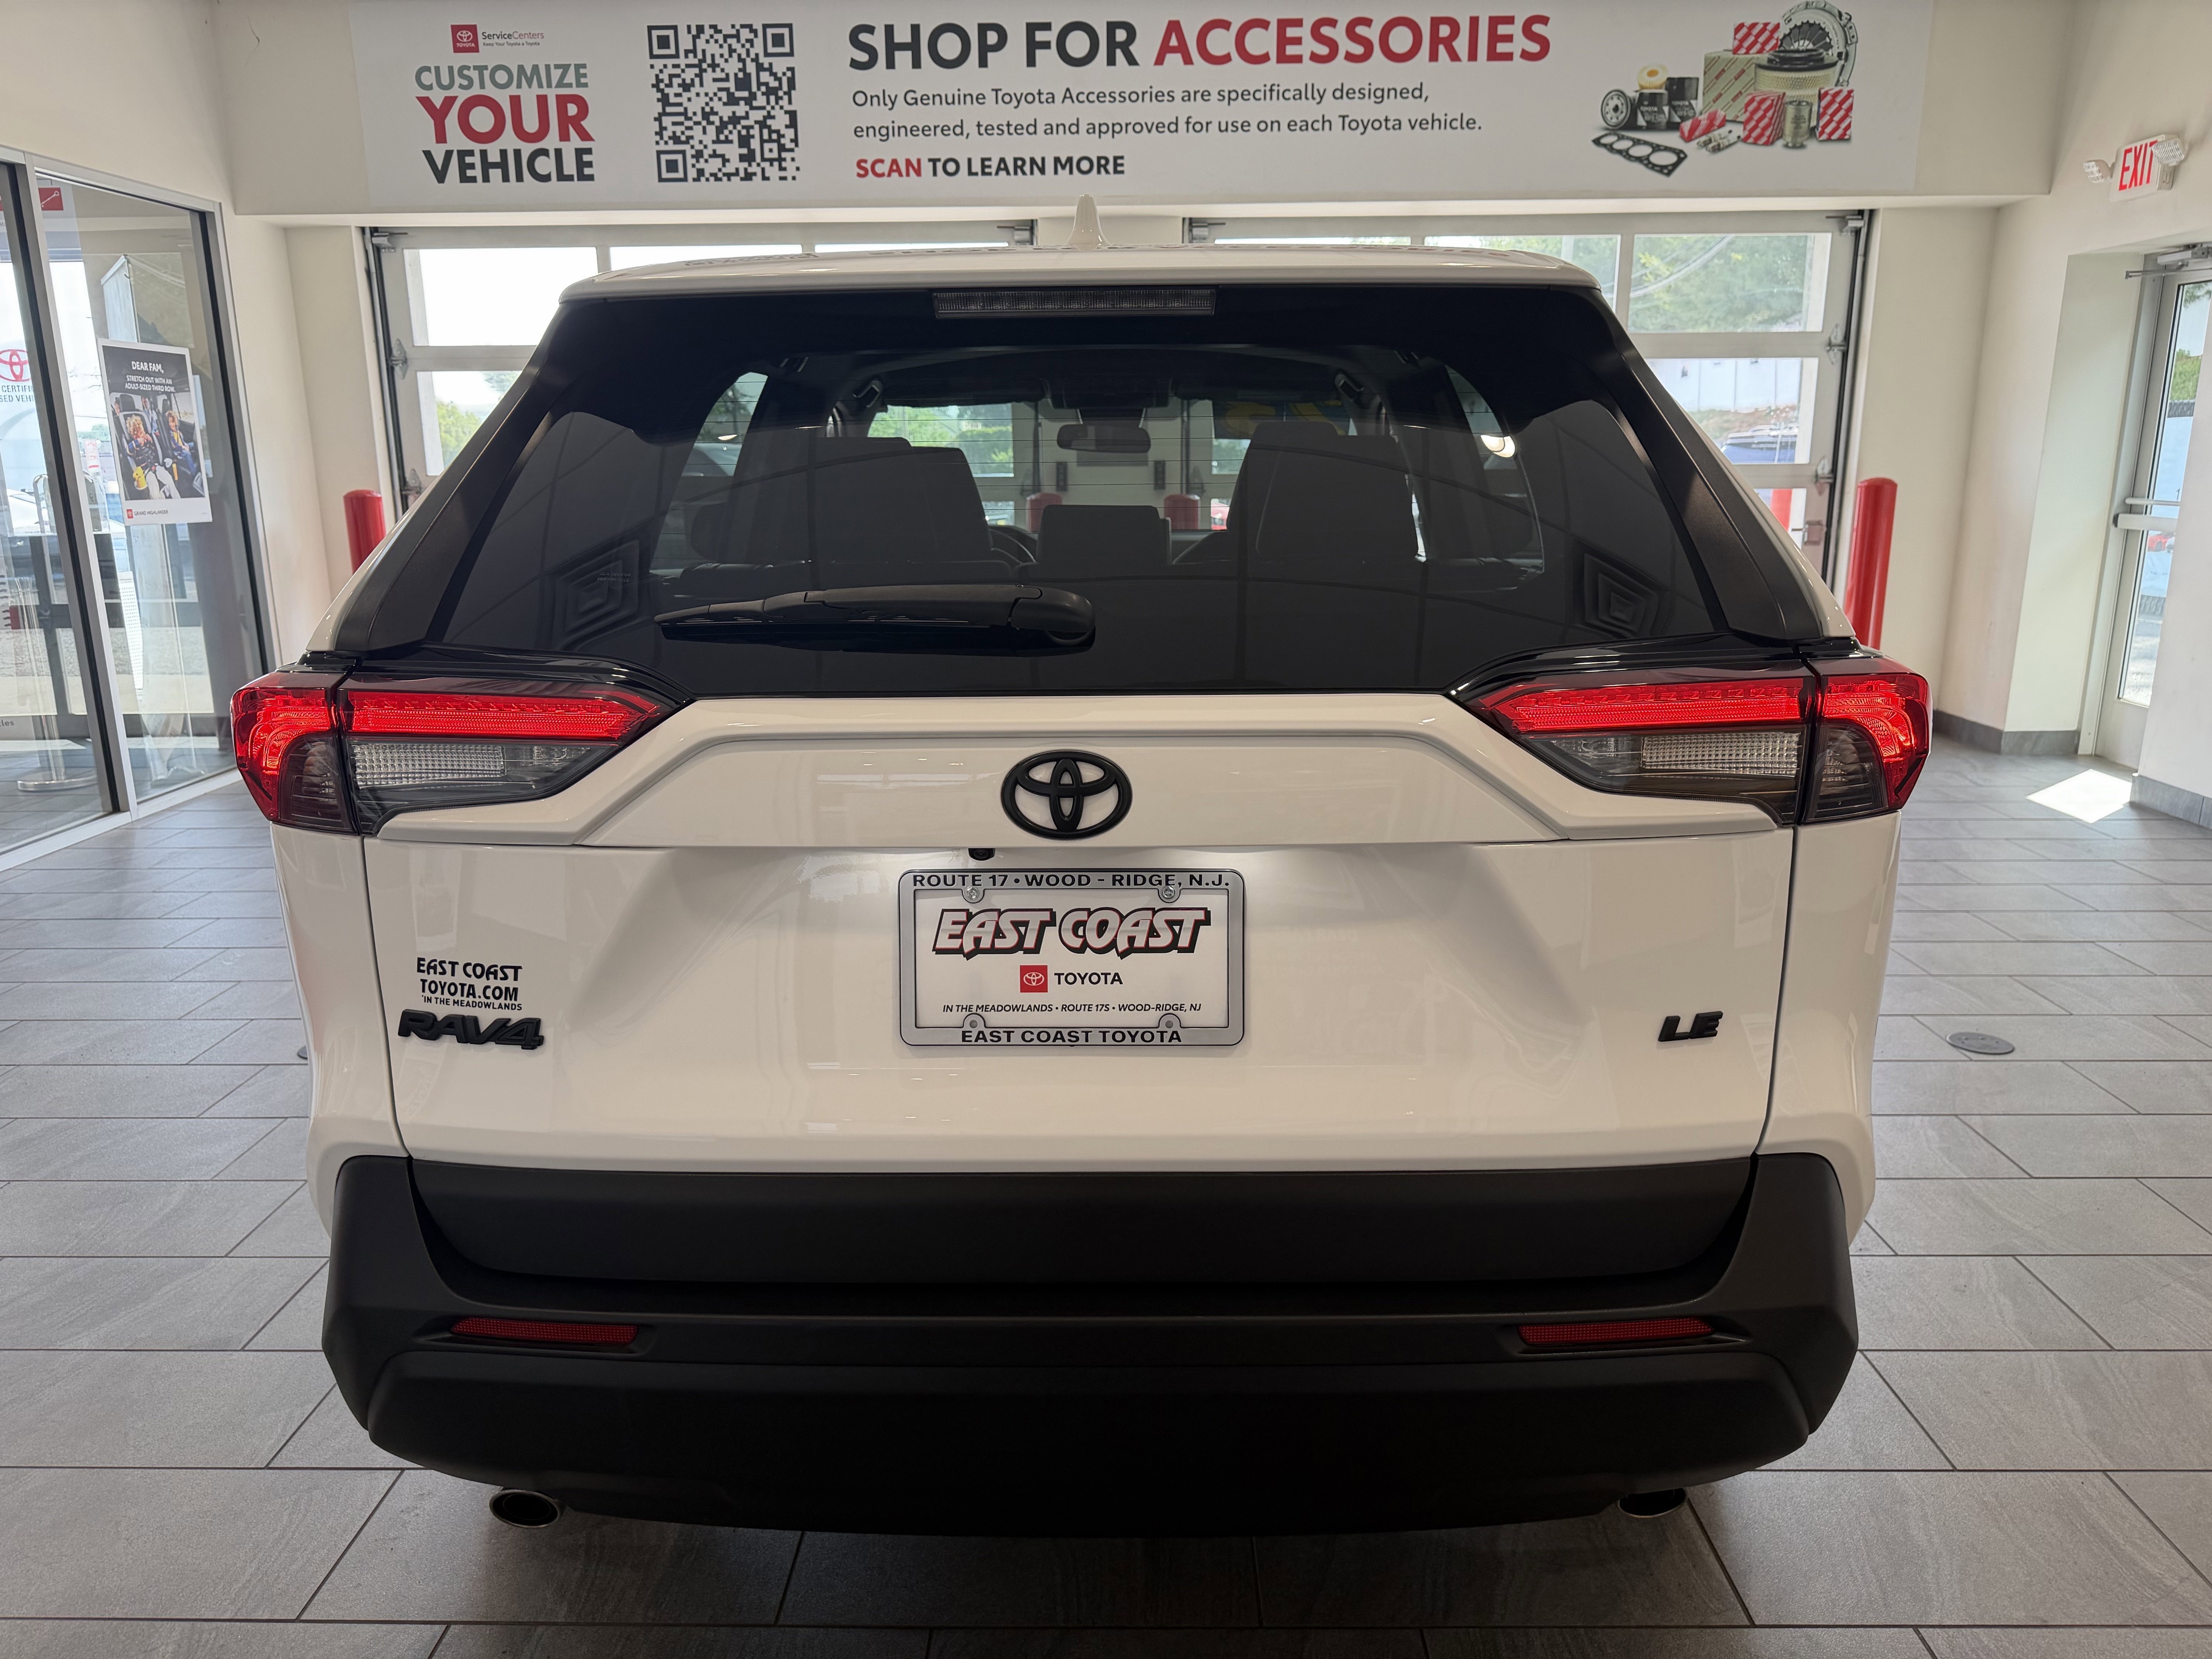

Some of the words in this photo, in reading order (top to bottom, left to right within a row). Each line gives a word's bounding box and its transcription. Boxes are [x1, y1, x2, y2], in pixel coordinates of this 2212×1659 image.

[482, 31, 544, 40] ServiceCenters
[849, 22, 1008, 70] SHOP
[1025, 21, 1139, 67] FOR
[1153, 15, 1551, 66] ACCESSORIES
[415, 64, 589, 91] CUSTOMIZE
[852, 89, 898, 110] Only
[904, 88, 986, 106] Genuine
[991, 87, 1055, 109] Toyota
[1062, 86, 1175, 104] Accessories
[1181, 88, 1211, 103] are
[1217, 83, 1327, 106] specifically
[1332, 82, 1429, 104] designed,
[416, 94, 595, 144] YOUR
[854, 119, 970, 141] engineered,
[976, 118, 1037, 136] tested
[1044, 117, 1080, 135] and
[1086, 116, 1178, 139] approved
[1184, 116, 1212, 133] for
[1218, 119, 1251, 132] use
[1257, 118, 1280, 132] on
[1287, 115, 1332, 131] each
[1338, 114, 1401, 135] Toyota
[1408, 113, 1482, 131] vehicle.
[422, 148, 595, 184] VEHICLE
[856, 158, 922, 178] SCAN
[928, 157, 960, 177] TO
[967, 156, 1046, 177] LEARN
[1054, 155, 1125, 175] MORE
[2118, 140, 2158, 191] EXIT
[132, 361, 148, 371] DEAR
[149, 363, 164, 373] FAM,
[914, 874, 981, 886] ROUTE
[989, 874, 1008, 886] 17
[1025, 874, 1091, 886] WOOD
[1112, 874, 1182, 888] RIDGE,
[1189, 874, 1229, 886] N.J.
[932, 908, 1056, 960] EAST
[1058, 907, 1211, 960] COAST
[417, 957, 459, 977] EAST
[463, 962, 522, 981] COAST
[1054, 972, 1123, 985] TOYOTA
[420, 979, 518, 1001] TOYOTA.COM
[434, 997, 450, 1005] THE
[453, 999, 522, 1010] MEADOWLANDS
[1061, 1004, 1093, 1012] ROUTE
[1118, 1003, 1187, 1012] WOOD-RIDGE,
[398, 1009, 544, 1050] RAV4
[962, 1030, 1015, 1042] EAST
[1021, 1030, 1092, 1042] COAST
[1099, 1030, 1182, 1042] TOYOTA
[1658, 1011, 1723, 1042] LE
